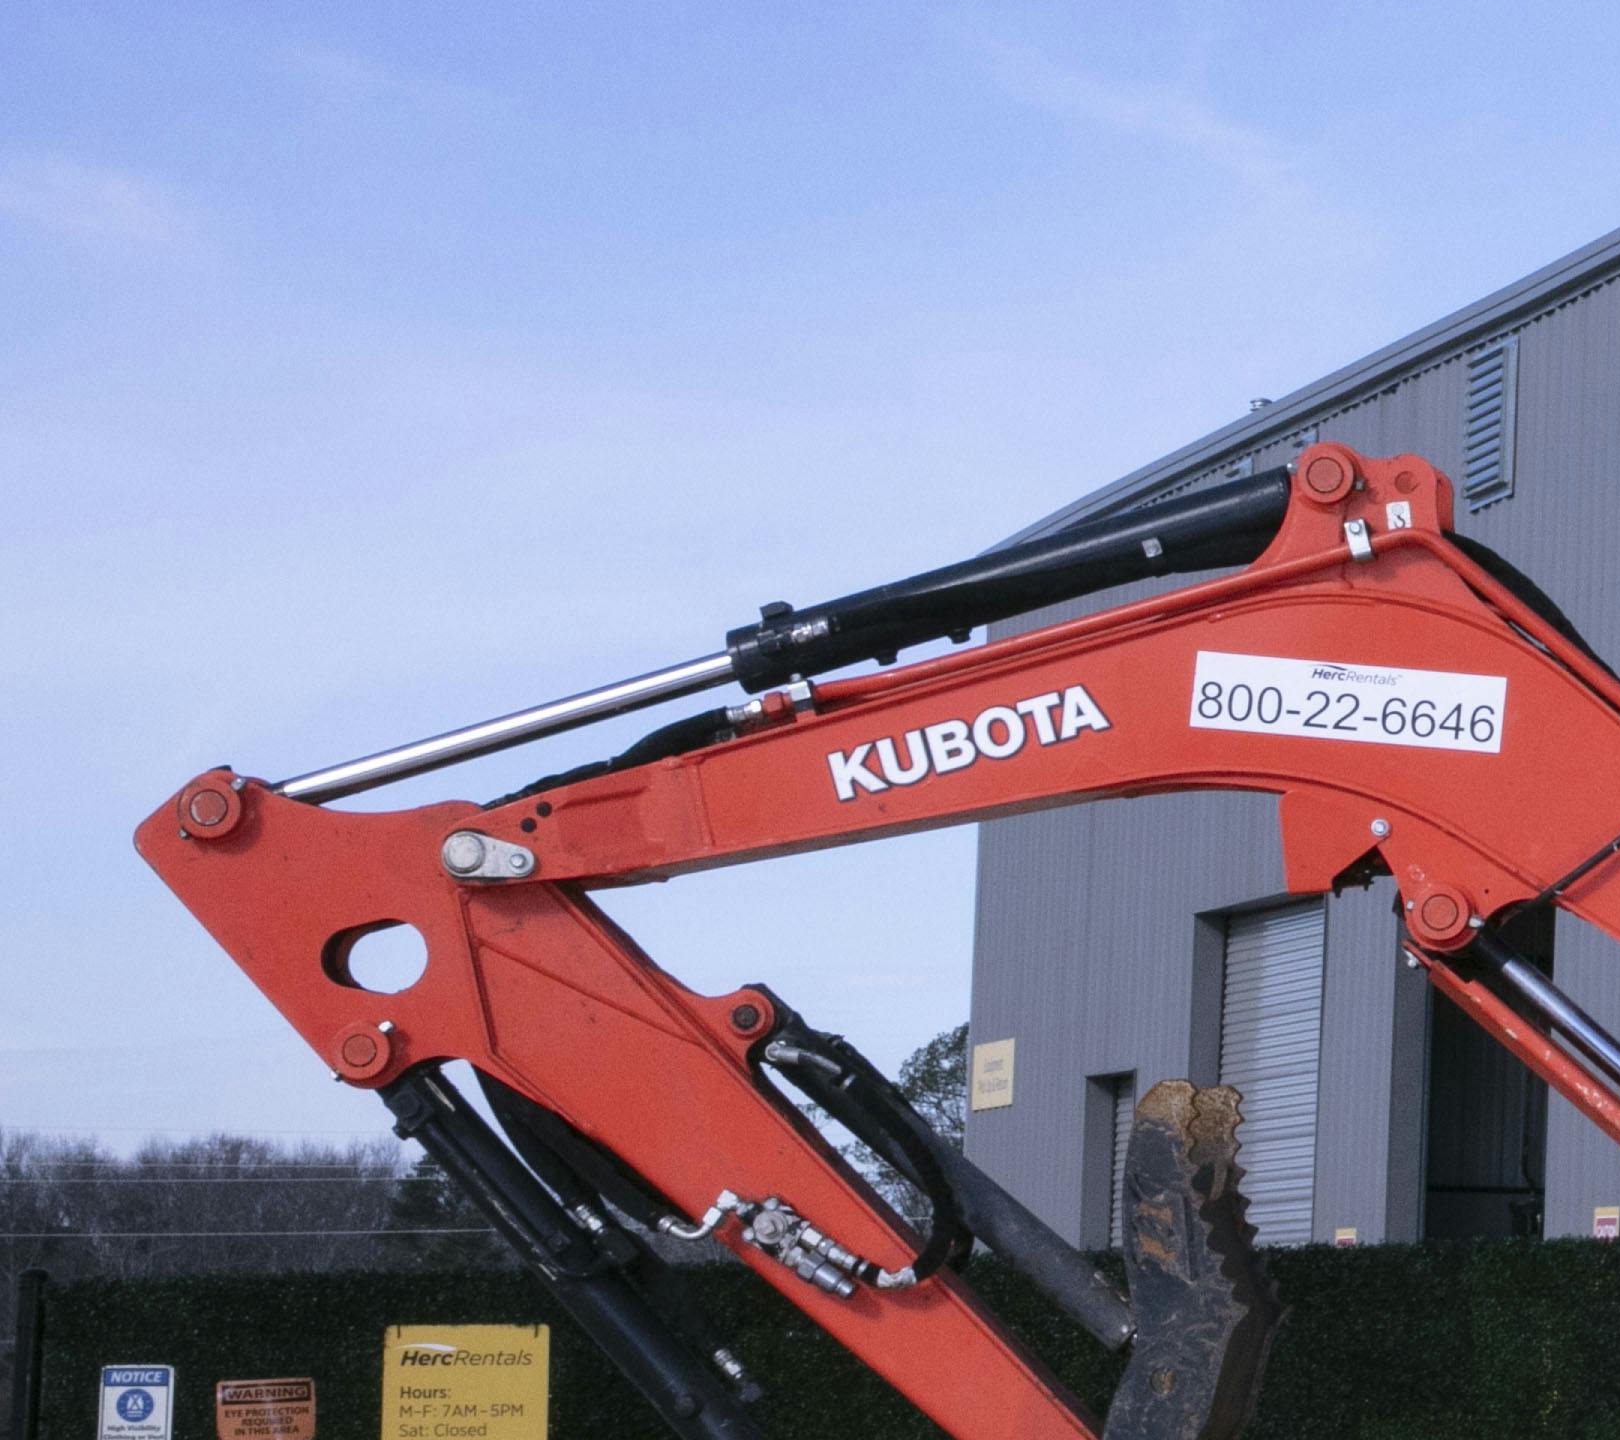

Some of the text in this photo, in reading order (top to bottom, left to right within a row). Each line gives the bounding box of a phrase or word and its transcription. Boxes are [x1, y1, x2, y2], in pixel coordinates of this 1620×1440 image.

[1311, 667, 1398, 687] HercRentals
[1198, 681, 1495, 743] 800-22-6646
[827, 684, 1111, 801] KUBOTA
[400, 1349, 534, 1367] HercRentals
[110, 1371, 163, 1384] NOTICE
[227, 1388, 308, 1401] WARNING
[400, 1386, 452, 1400] Hours:
[245, 1407, 310, 1418] PROTECTION
[249, 1428, 270, 1436] THIS
[399, 1423, 488, 1437] Sat: Closed
